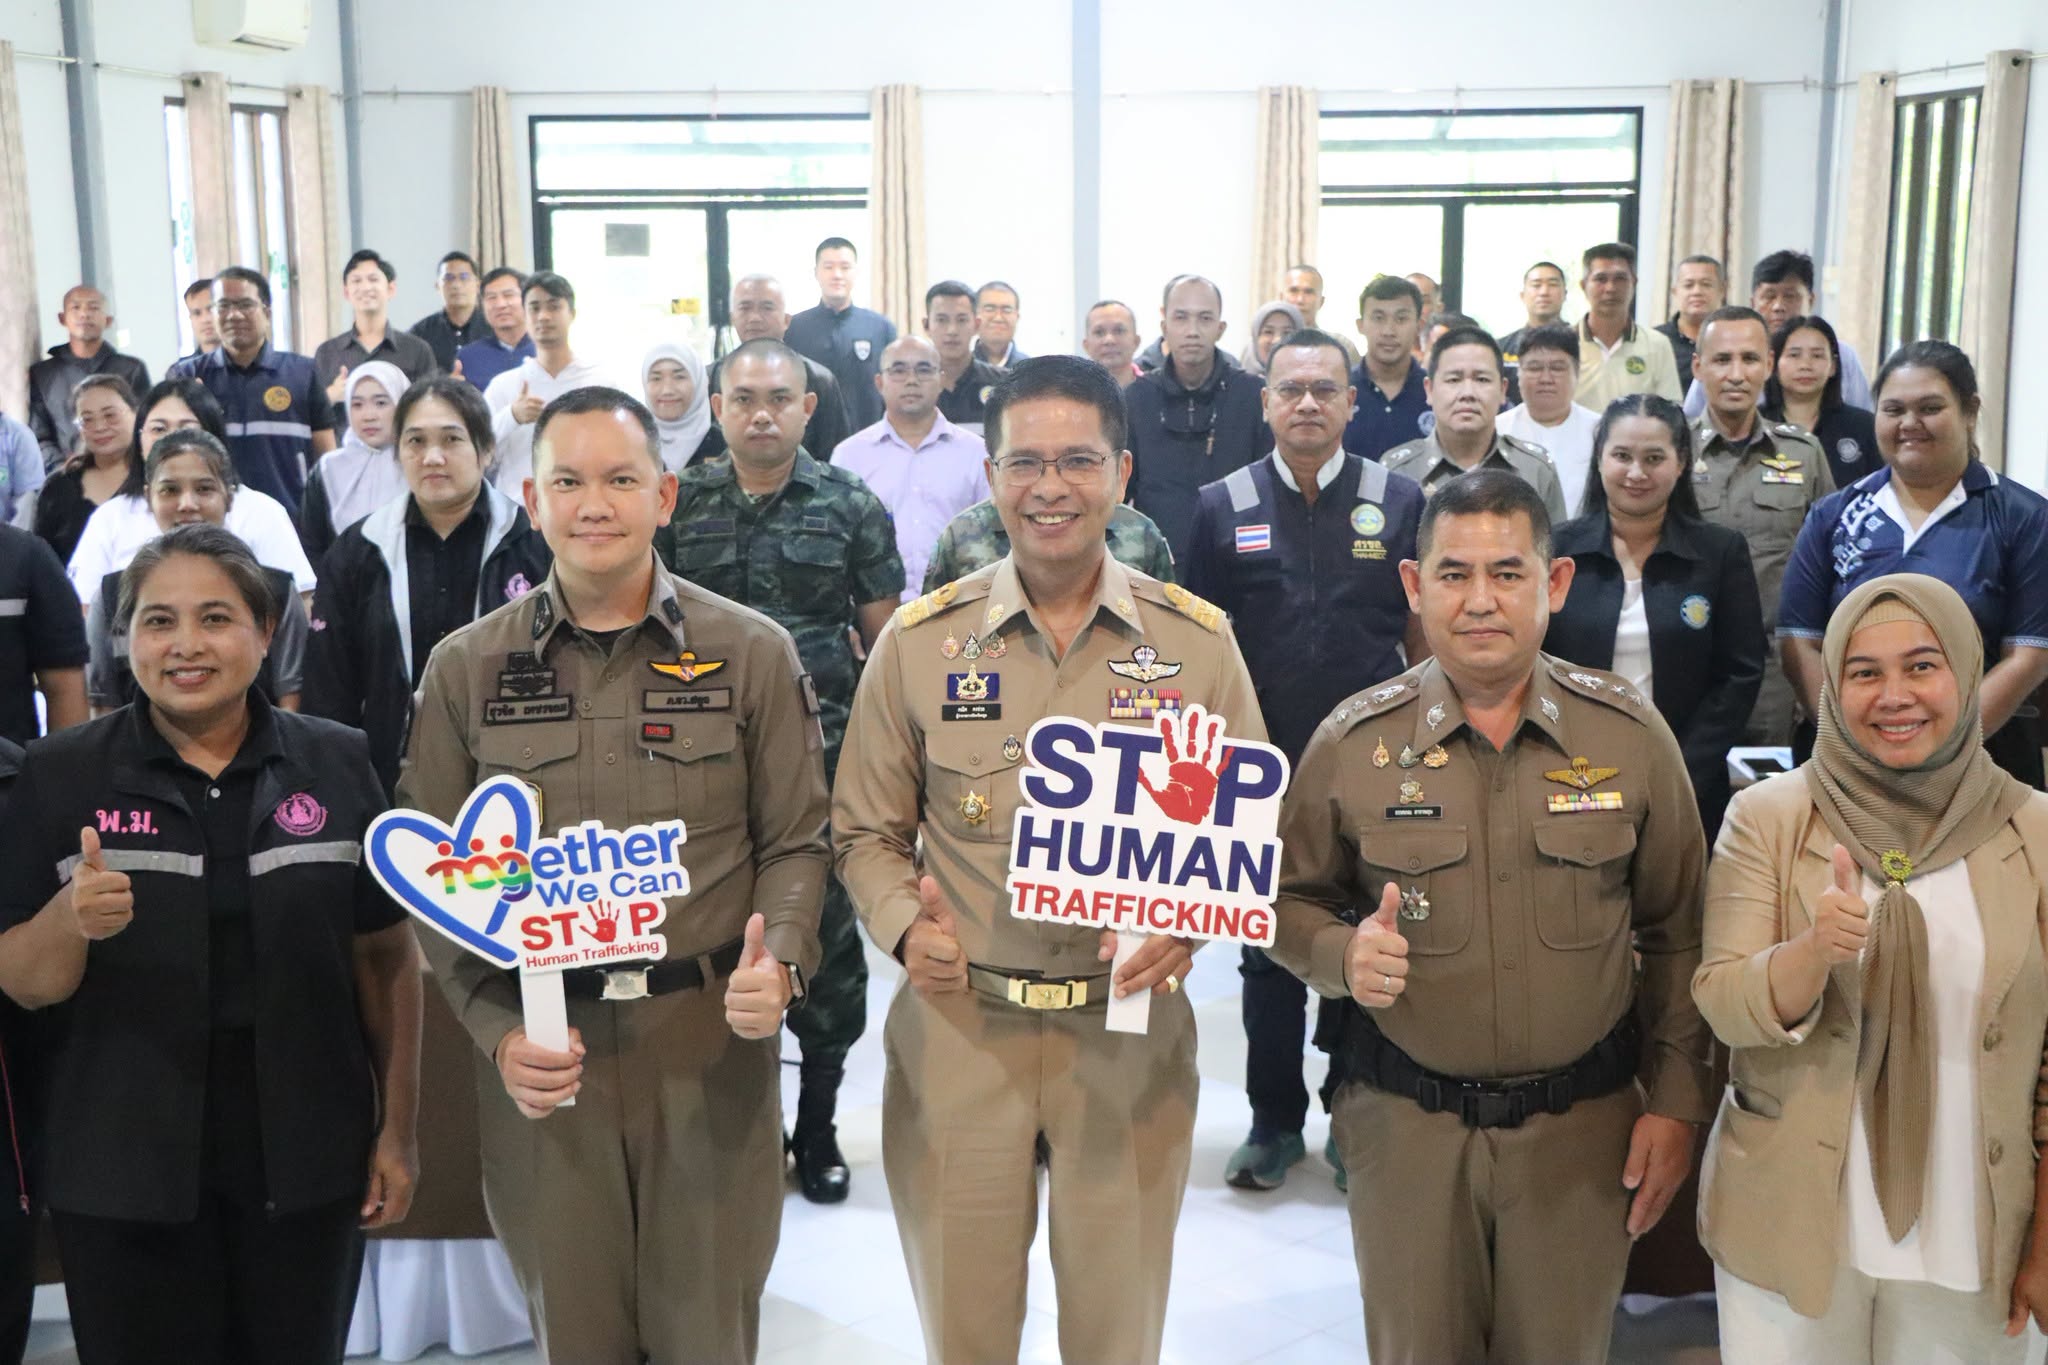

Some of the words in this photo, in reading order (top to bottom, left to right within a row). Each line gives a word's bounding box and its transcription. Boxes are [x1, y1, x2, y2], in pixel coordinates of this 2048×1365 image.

[1025, 711, 1283, 828] STOP
[95, 808, 159, 835] พ.ม.
[425, 827, 680, 903] Together
[1015, 815, 1275, 897] HUMAN
[536, 880, 599, 907] We
[609, 871, 683, 898] Can
[1012, 882, 1270, 941] TRAFFICKING
[520, 898, 660, 951] STOP
[525, 948, 579, 969] Human
[582, 940, 660, 966] Trafficking
